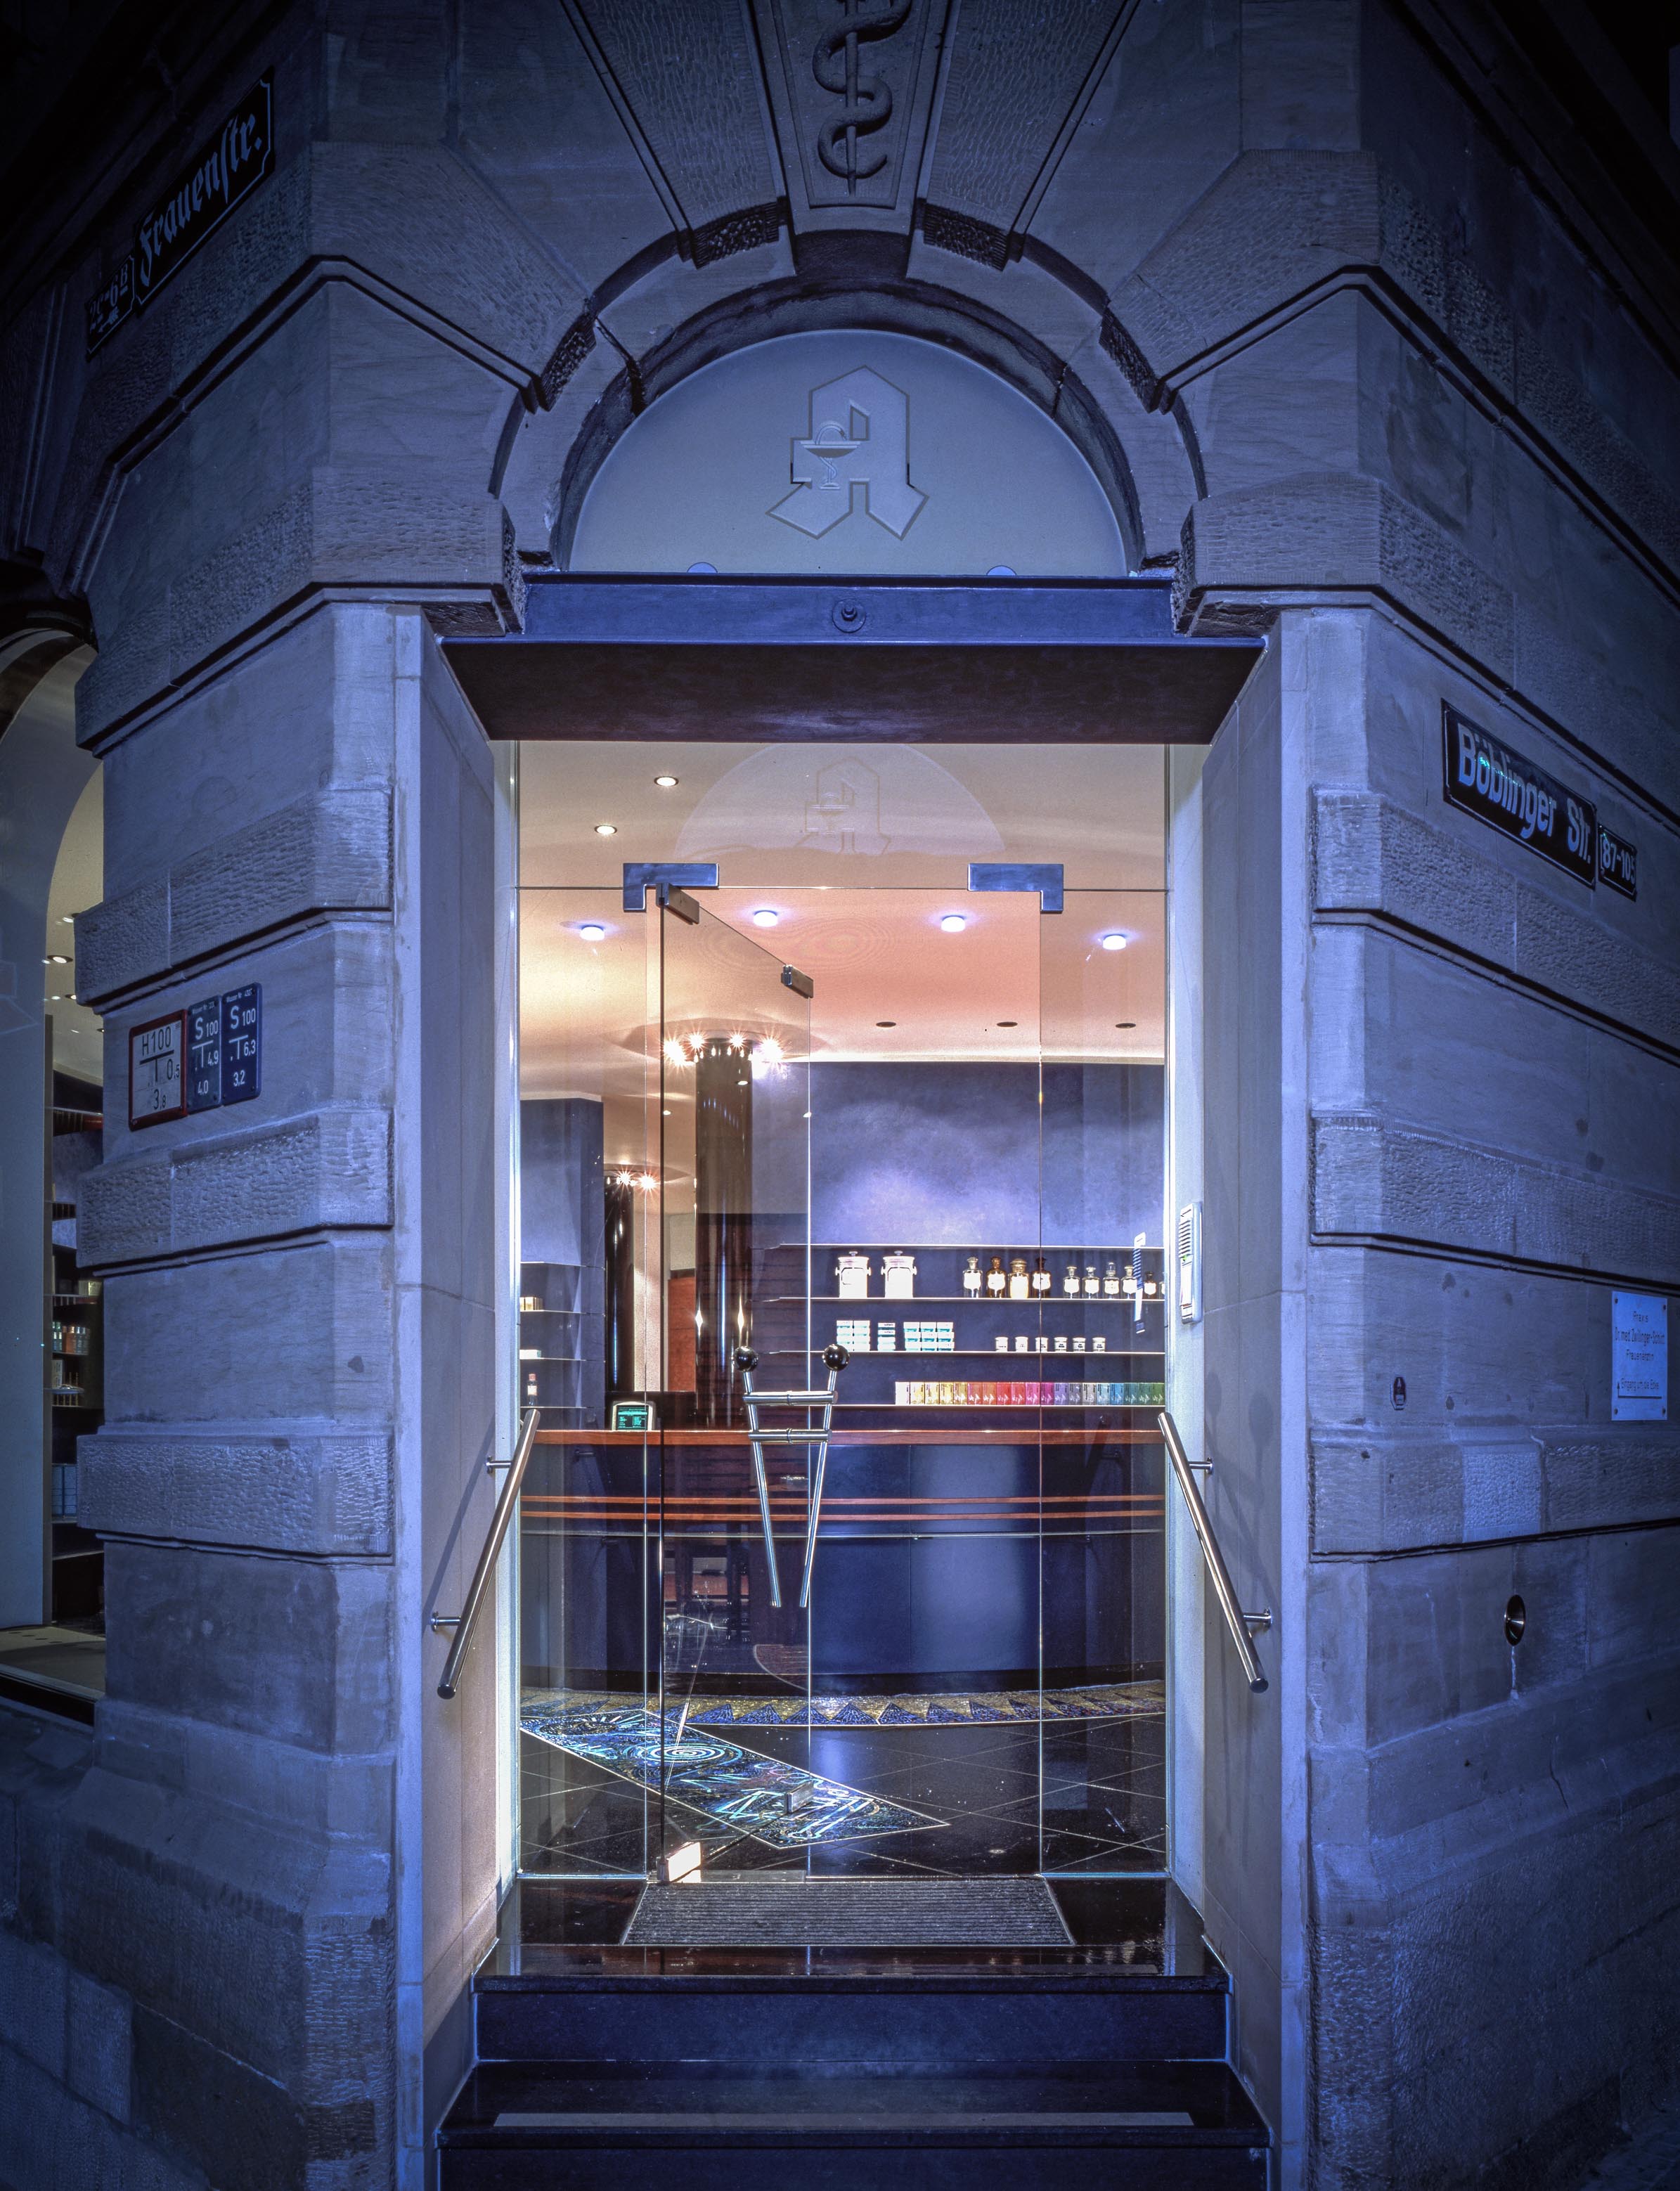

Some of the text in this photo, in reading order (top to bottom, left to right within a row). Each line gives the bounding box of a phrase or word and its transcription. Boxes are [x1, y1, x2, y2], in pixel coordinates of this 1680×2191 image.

[1457, 722, 1591, 864] Böblinger Str.
[1603, 836, 1636, 885] 87-105
[195, 1016, 219, 1040] S 100
[230, 1005, 256, 1029] S 100
[142, 1026, 171, 1056] H100
